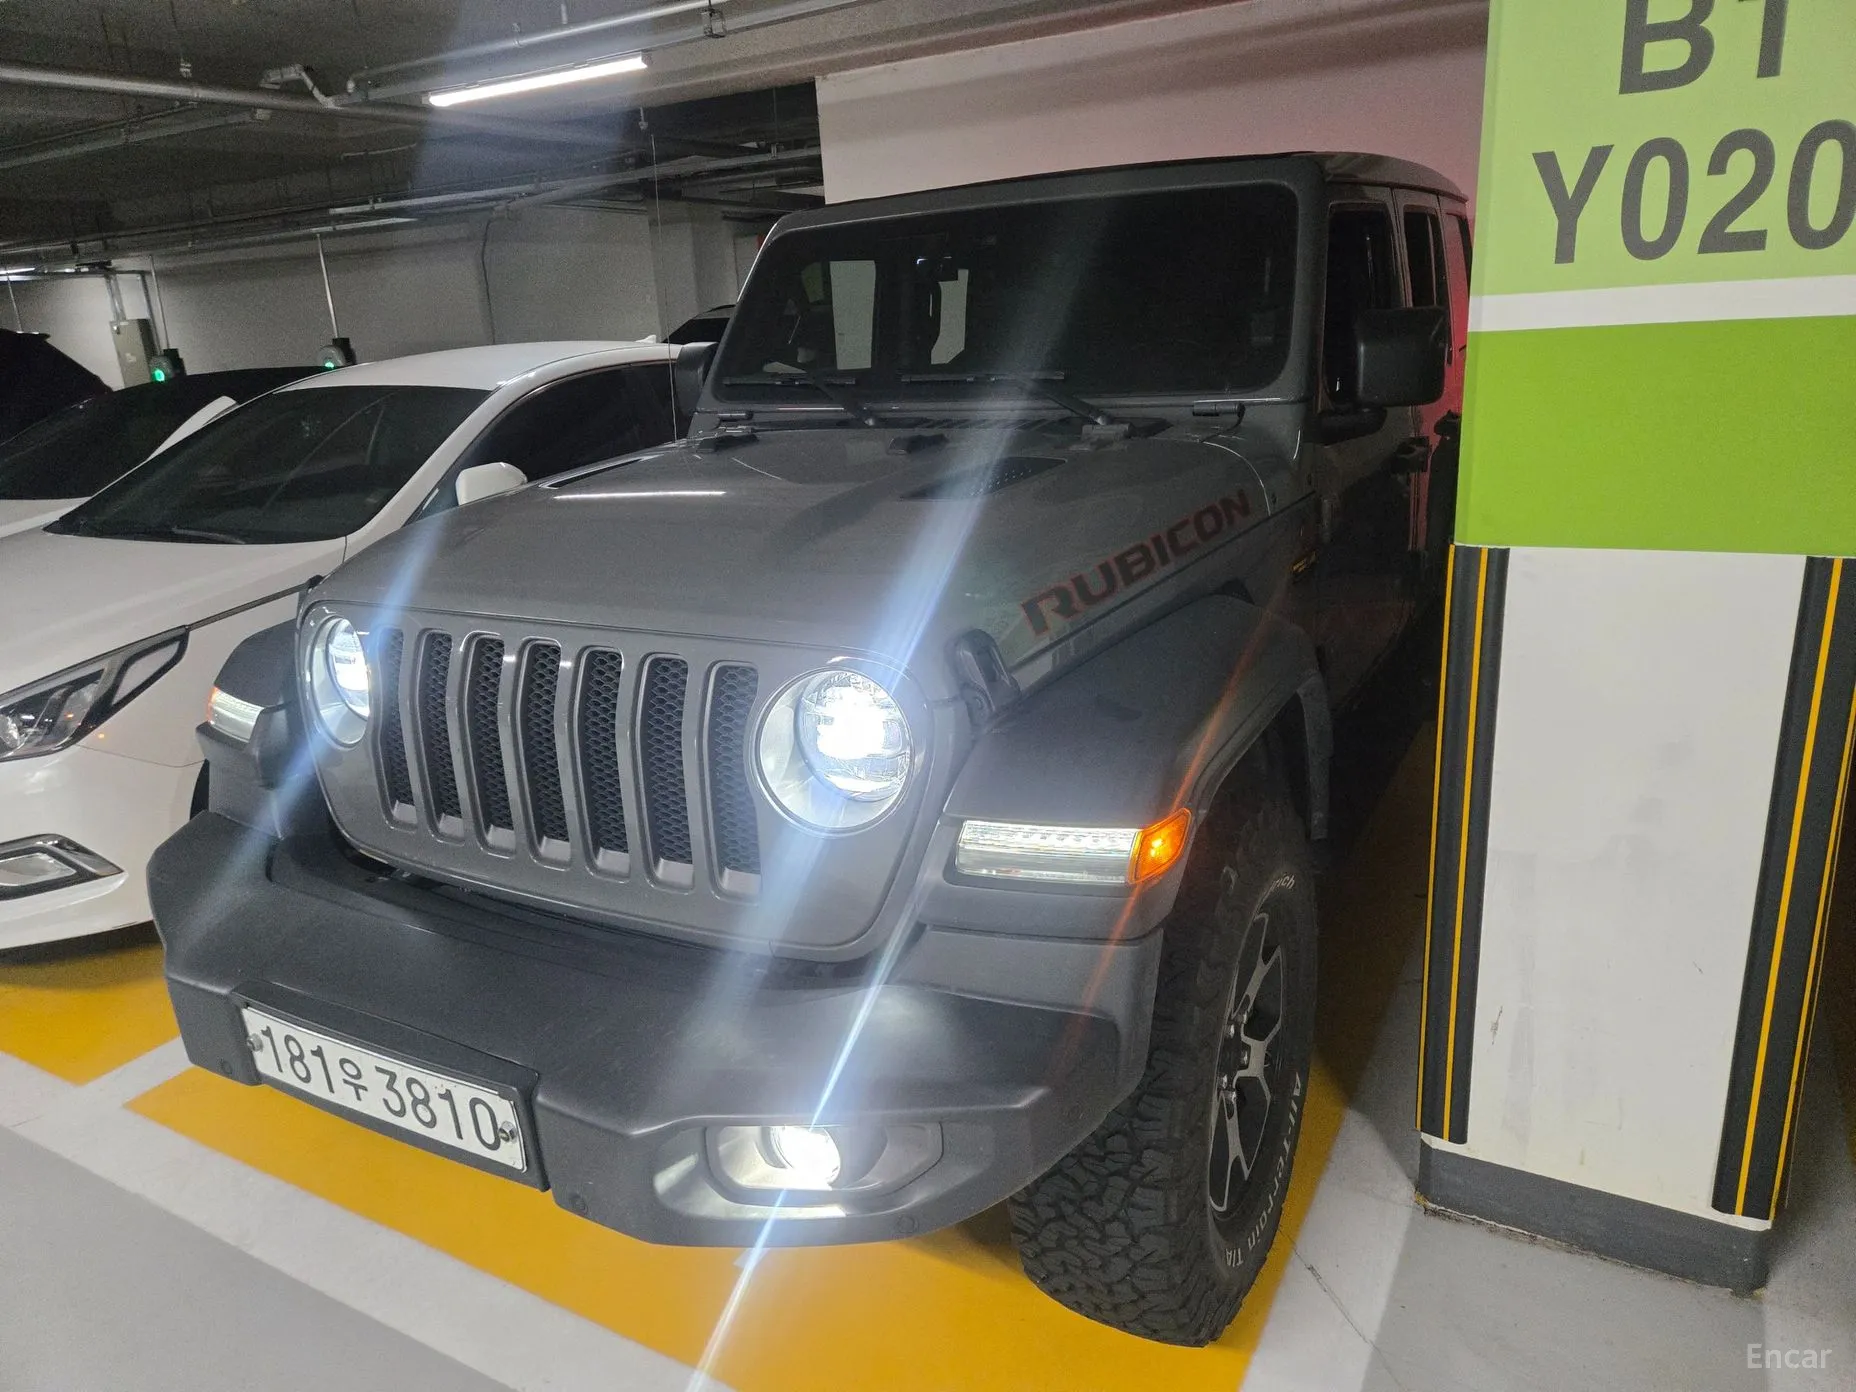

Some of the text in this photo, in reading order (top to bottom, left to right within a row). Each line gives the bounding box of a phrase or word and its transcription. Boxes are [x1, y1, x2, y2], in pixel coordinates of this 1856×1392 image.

[1618, 0, 1789, 95] B1
[1531, 118, 1856, 265] Y020
[1020, 488, 1250, 637] RUBICON
[261, 1025, 501, 1151] 181우3810
[1247, 1071, 1301, 1251] All-Terrain
